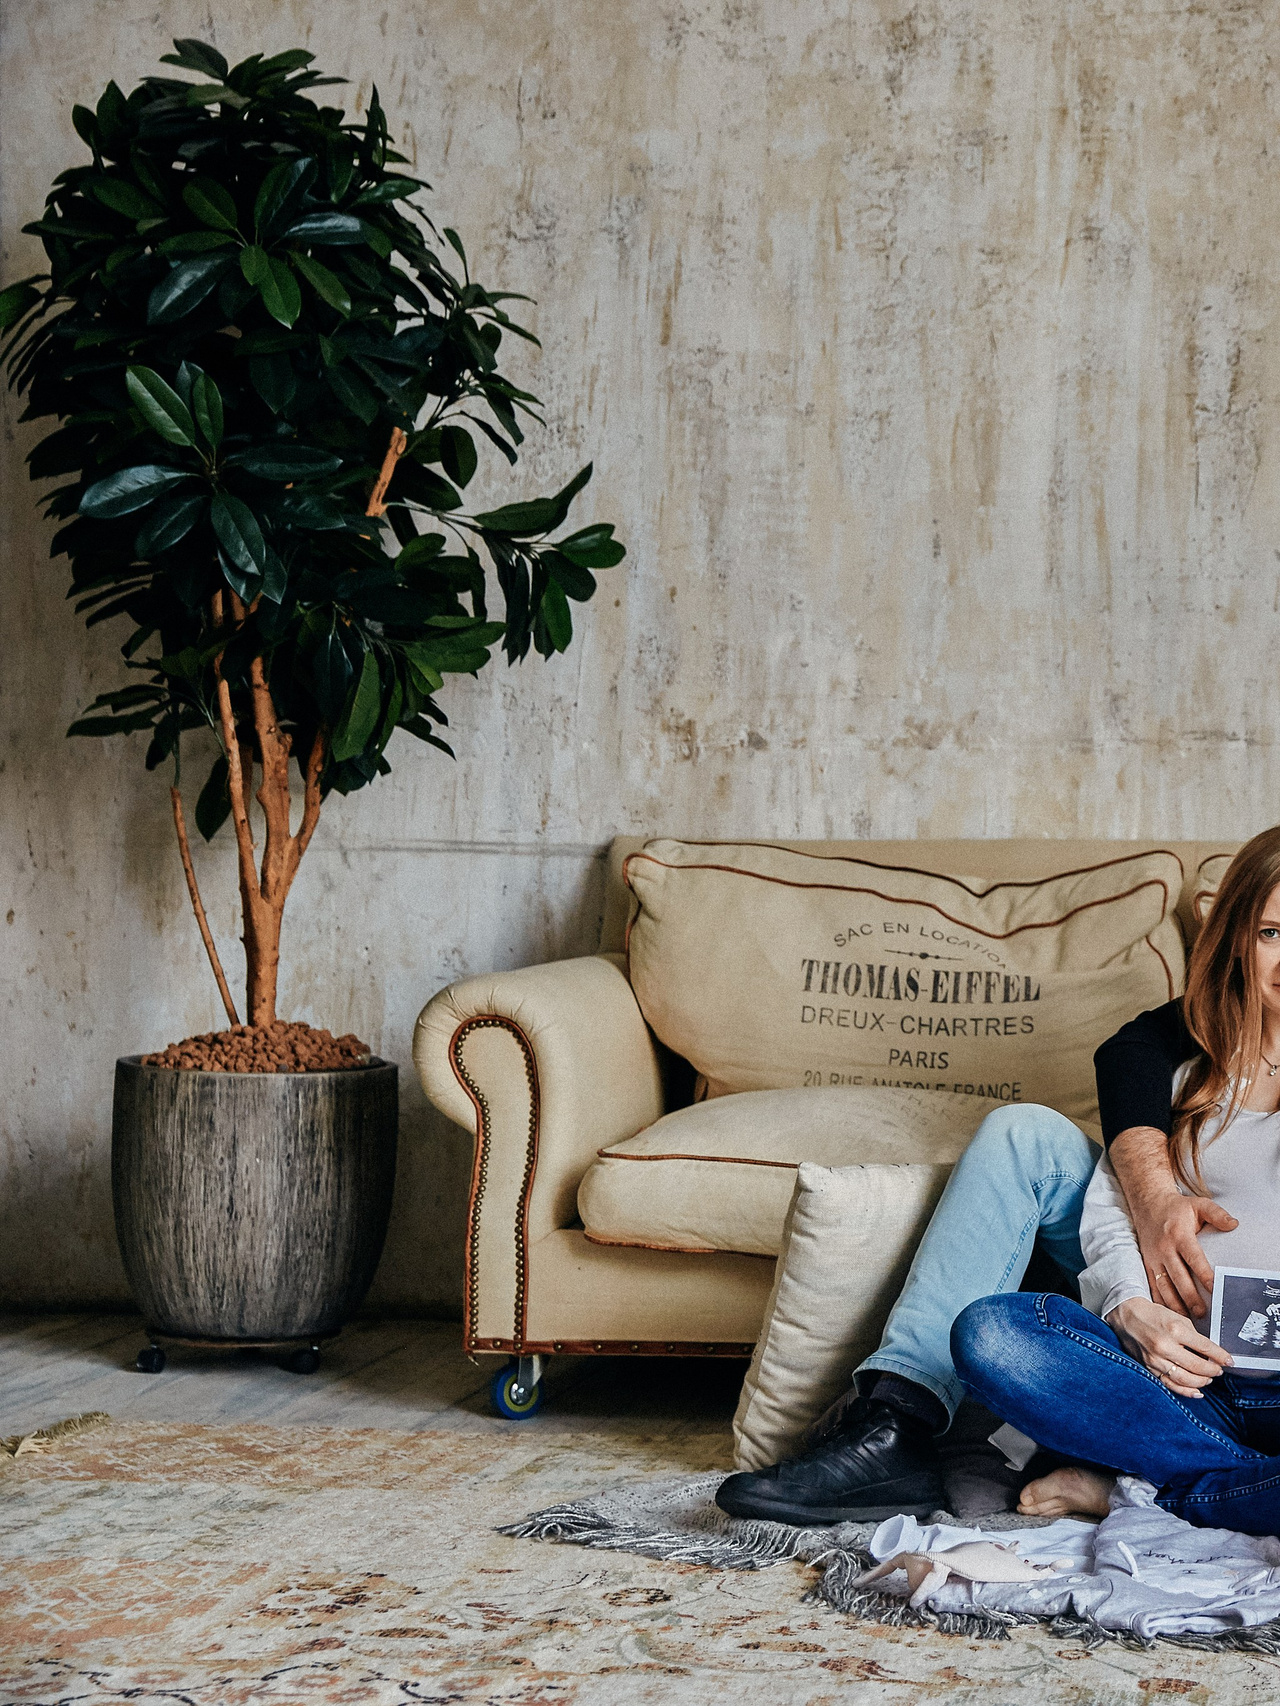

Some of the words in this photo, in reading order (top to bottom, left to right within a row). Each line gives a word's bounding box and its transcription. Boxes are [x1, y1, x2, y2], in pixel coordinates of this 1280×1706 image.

[834, 922, 873, 948] SAC
[883, 921, 910, 934] EN
[801, 958, 1041, 1005] THOMAS-EIFFEL
[801, 1005, 1035, 1037] DREUX-CHARTRES
[888, 1048, 949, 1070] PARIS
[803, 1069, 822, 1087] 20
